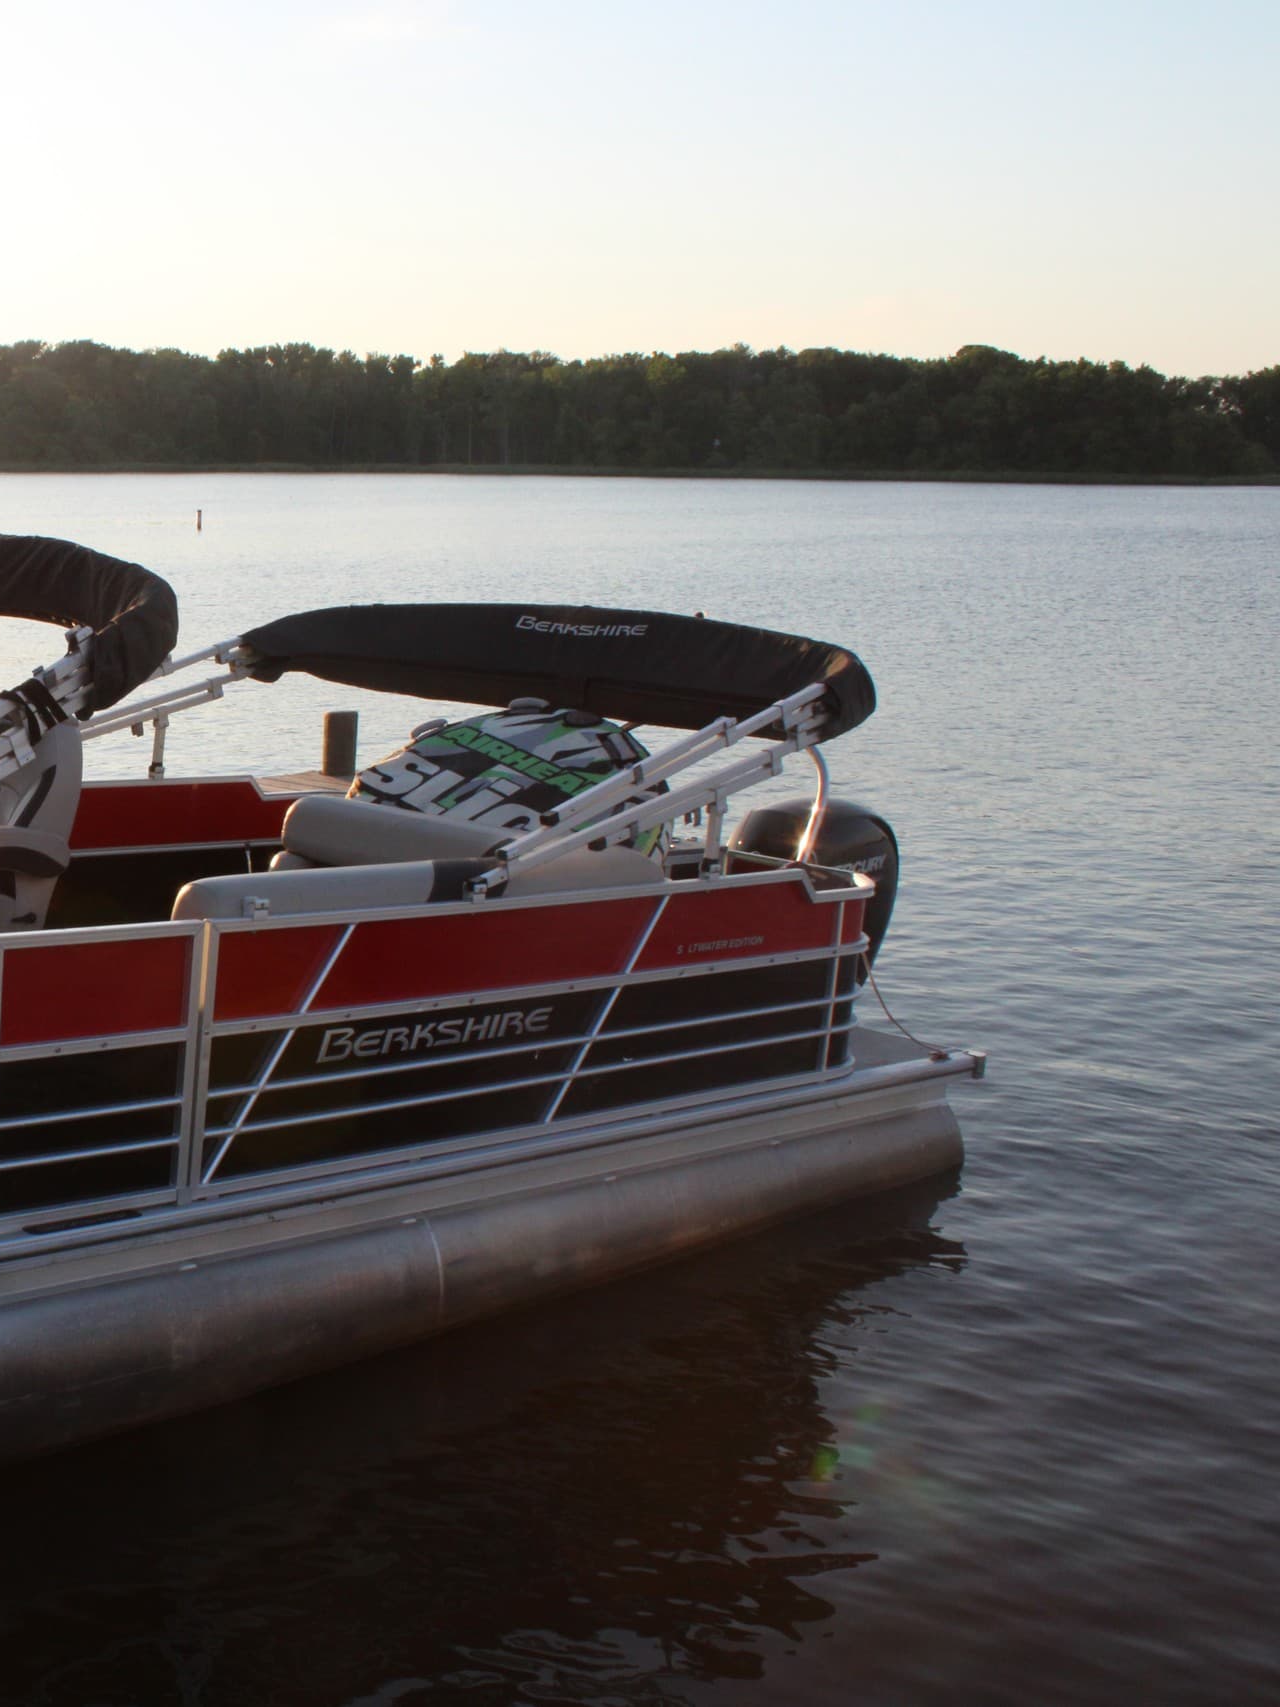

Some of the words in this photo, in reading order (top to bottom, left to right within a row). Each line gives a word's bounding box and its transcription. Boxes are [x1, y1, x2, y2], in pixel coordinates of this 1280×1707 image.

[515, 615, 648, 637] BERKSHIRE
[442, 726, 597, 796] AIRHEA
[676, 939, 728, 955] SLTWATER
[729, 935, 765, 949] EDITION
[317, 1006, 554, 1065] BERKSHIRE
